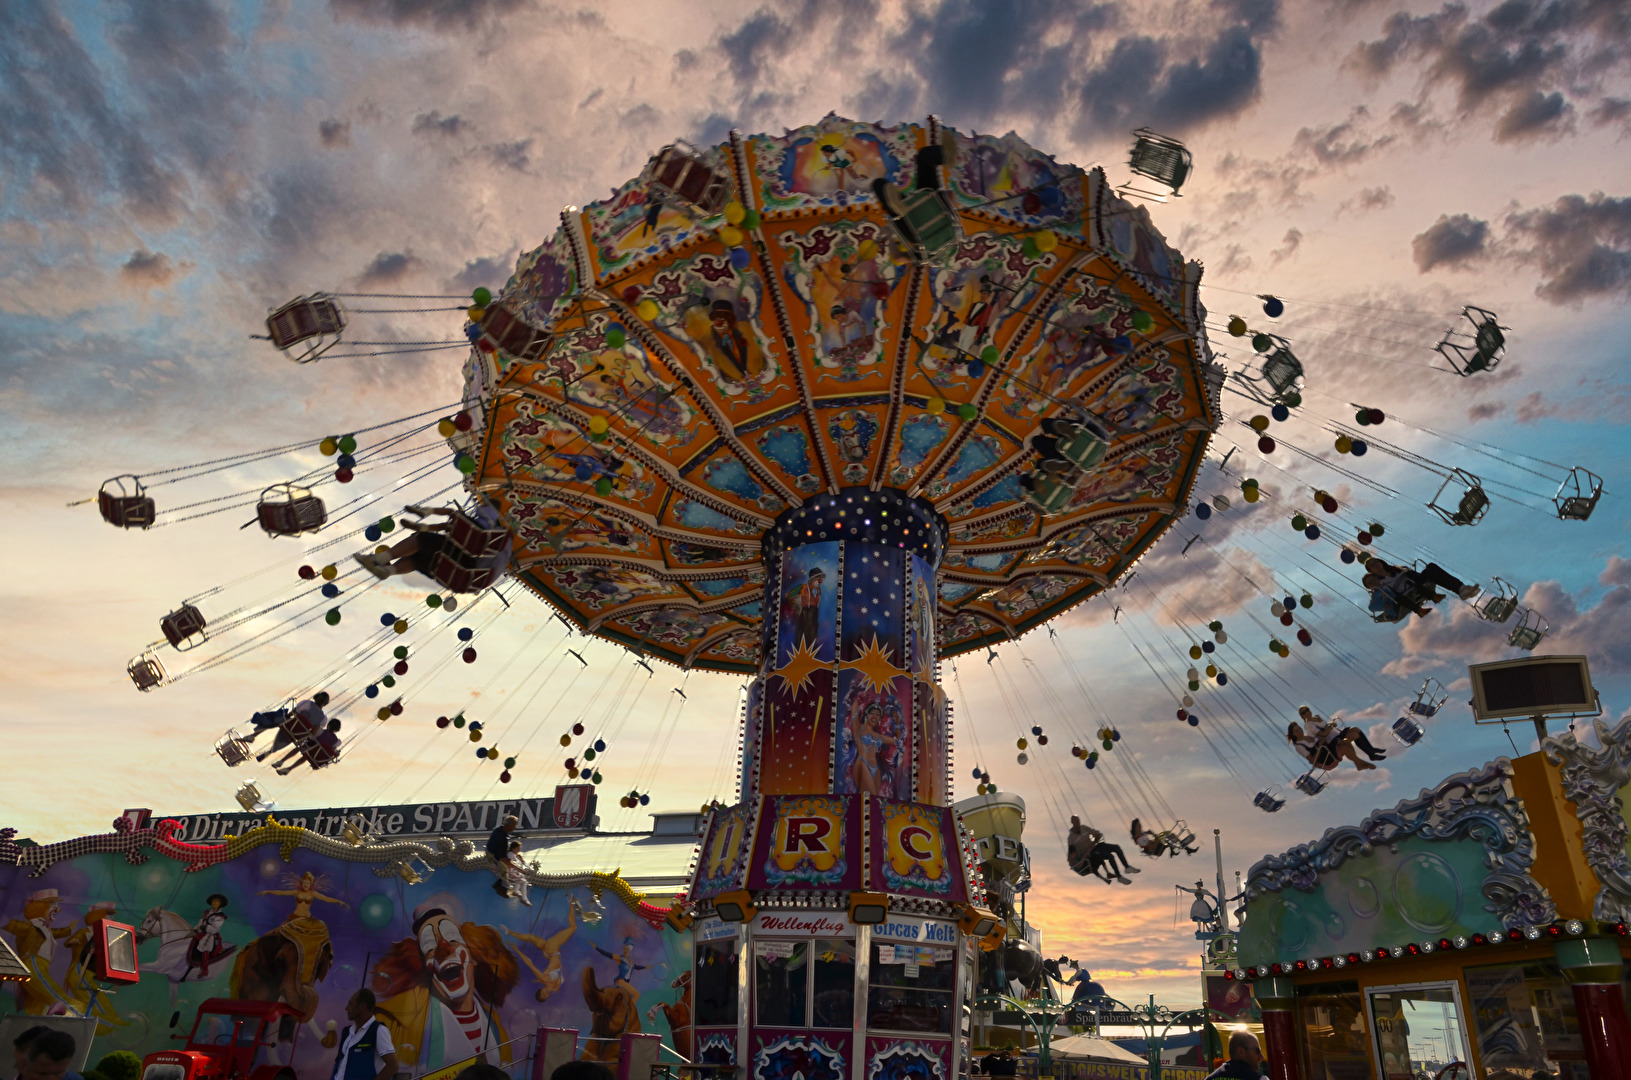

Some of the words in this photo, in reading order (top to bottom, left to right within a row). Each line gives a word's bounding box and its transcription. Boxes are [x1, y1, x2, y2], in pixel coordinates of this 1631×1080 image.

[190, 813, 234, 841] Dir
[313, 808, 404, 835] trinke
[412, 800, 545, 833] SPATEN
[557, 815, 565, 823] G
[573, 814, 579, 822] S
[784, 816, 832, 853] R
[899, 826, 934, 861] C
[760, 916, 844, 935] Wellenflug
[873, 923, 919, 938] Circus
[925, 922, 955, 942] Welt
[1075, 1013, 1132, 1024] Spaenbräu
